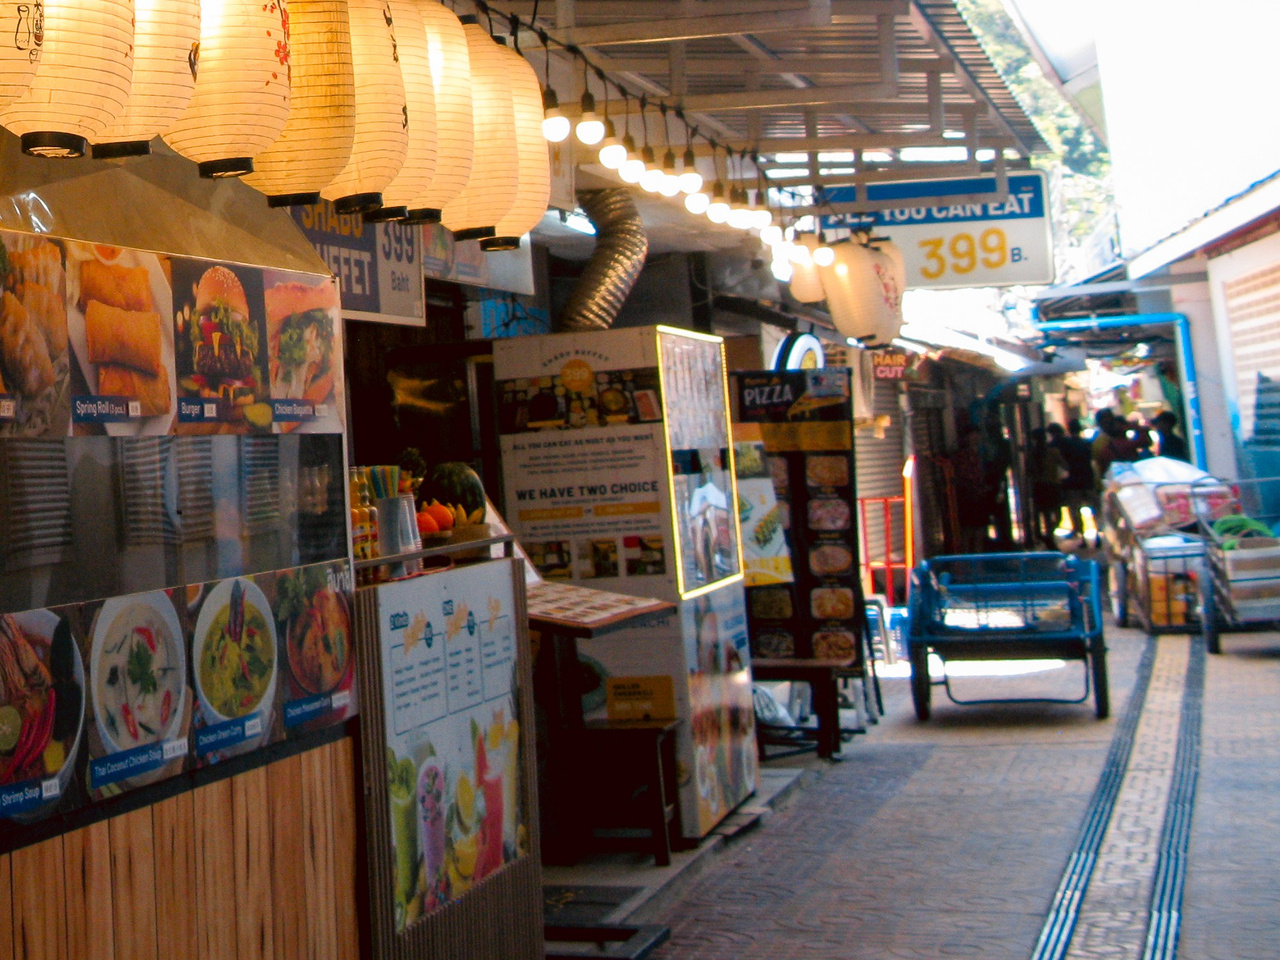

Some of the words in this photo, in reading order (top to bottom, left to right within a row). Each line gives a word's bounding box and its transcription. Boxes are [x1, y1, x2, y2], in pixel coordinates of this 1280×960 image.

[986, 193, 1035, 216] EAT
[382, 221, 414, 265] 399
[918, 226, 1008, 280] 399
[1010, 247, 1029, 263] B.
[874, 354, 907, 366] HAIR
[876, 366, 905, 379] CUT
[744, 383, 793, 407] PIZZA
[76, 400, 97, 417] Spring
[97, 400, 109, 414] Roll
[181, 402, 201, 418] Burger
[515, 488, 536, 501] WE
[539, 486, 575, 499] HAVE
[578, 484, 607, 497] TWO
[610, 480, 659, 495] CHOICE
[128, 752, 149, 768] Chicken
[148, 748, 162, 763] Soup
[1, 791, 25, 809] Shrimp
[24, 785, 41, 804] Soup
